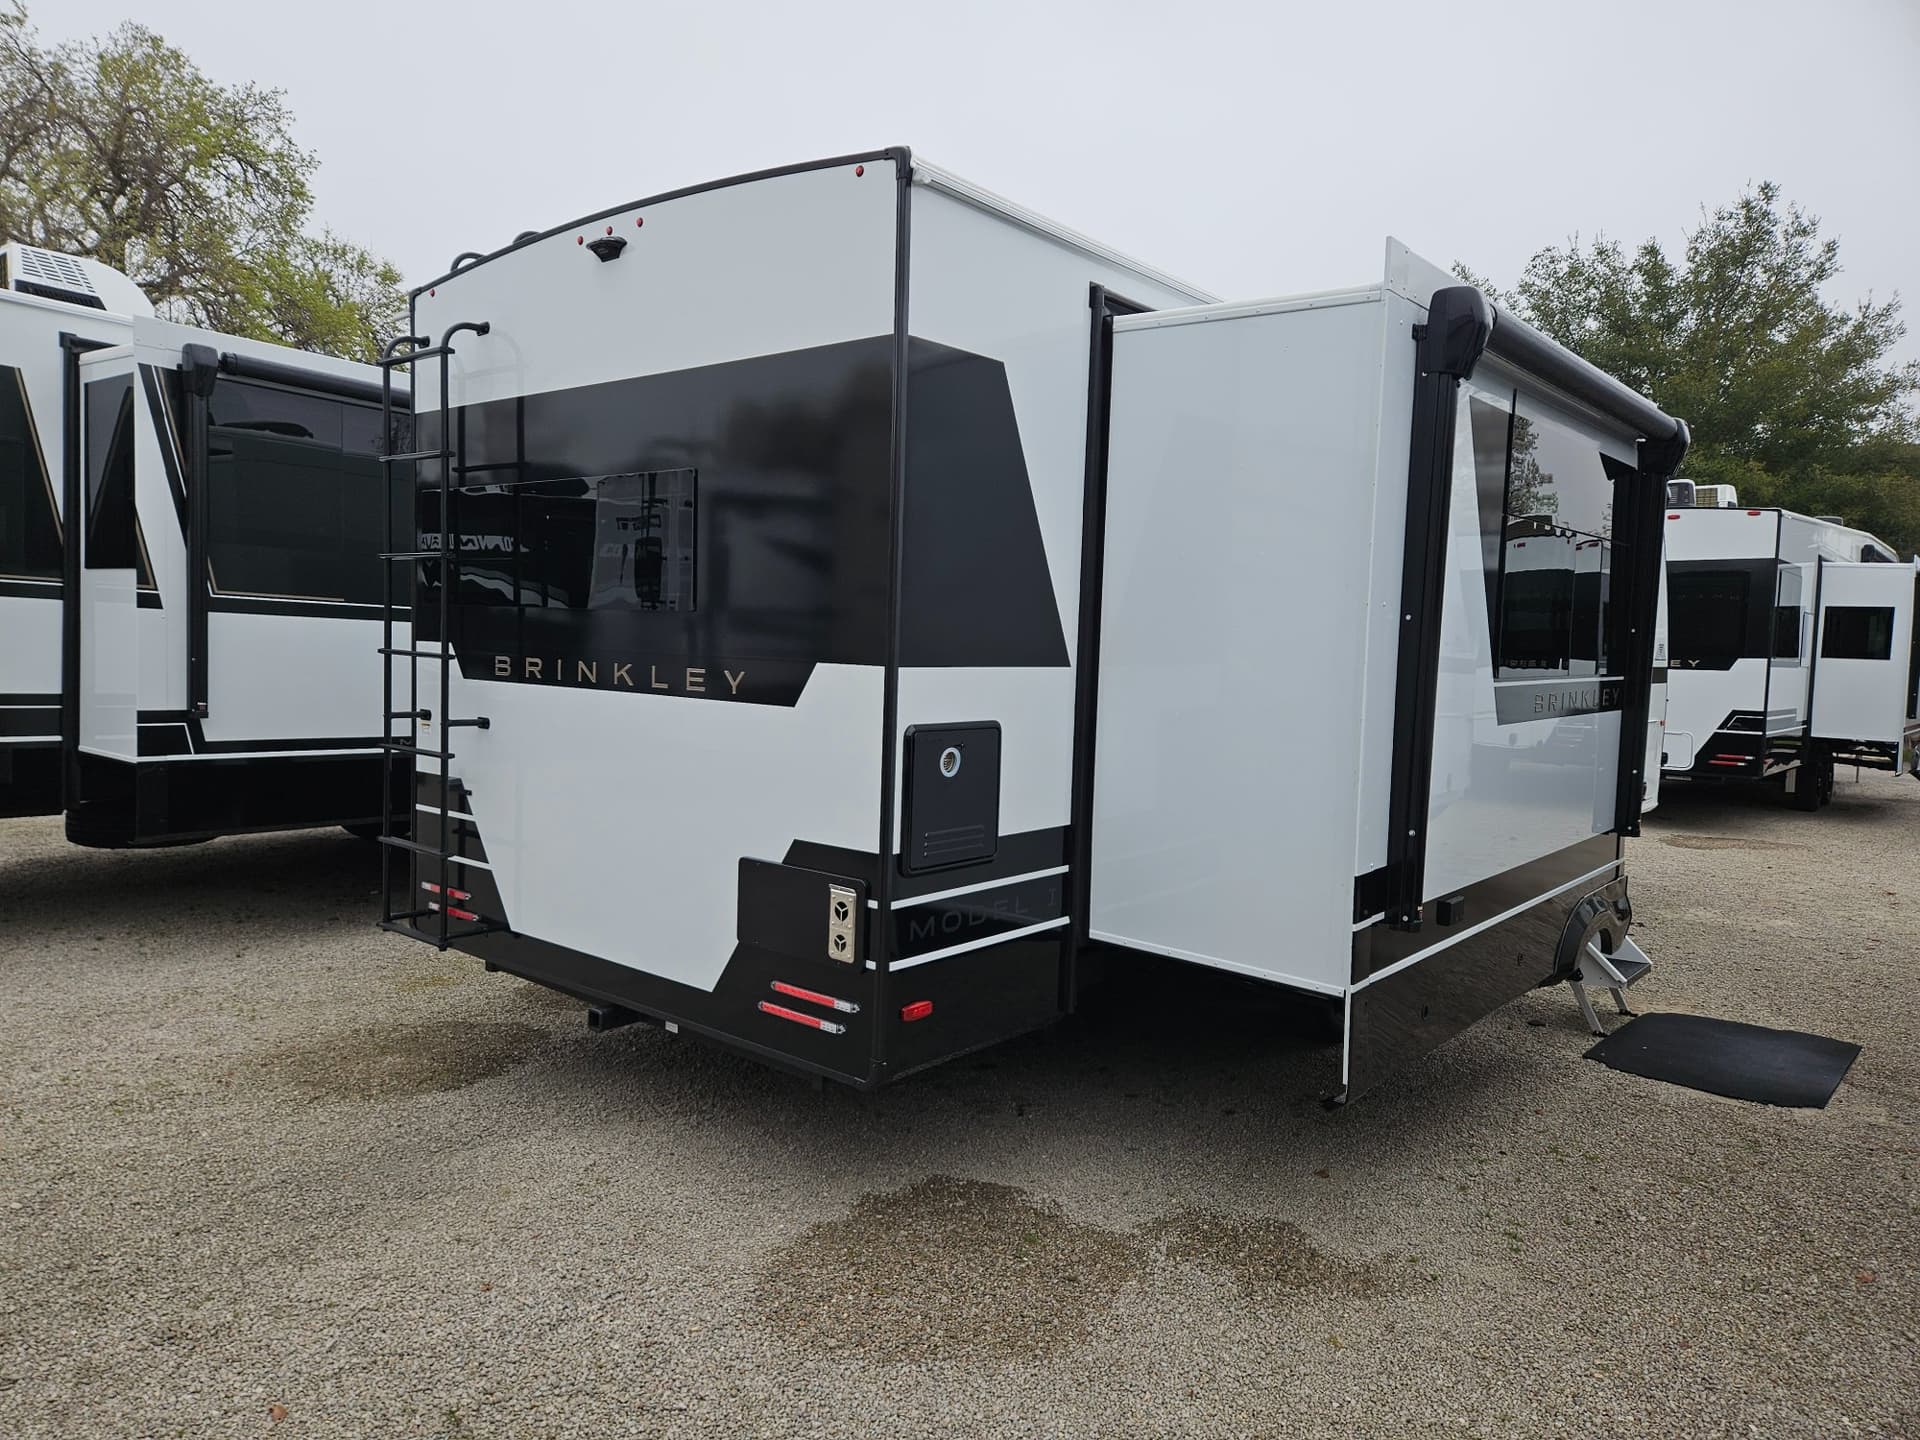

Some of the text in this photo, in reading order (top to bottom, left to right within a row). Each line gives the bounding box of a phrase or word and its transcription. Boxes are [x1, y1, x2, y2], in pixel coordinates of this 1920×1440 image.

[494, 656, 745, 694] BRINKLEY
[1534, 688, 1620, 713] BRINKLEY
[909, 896, 1030, 941] MODEL
